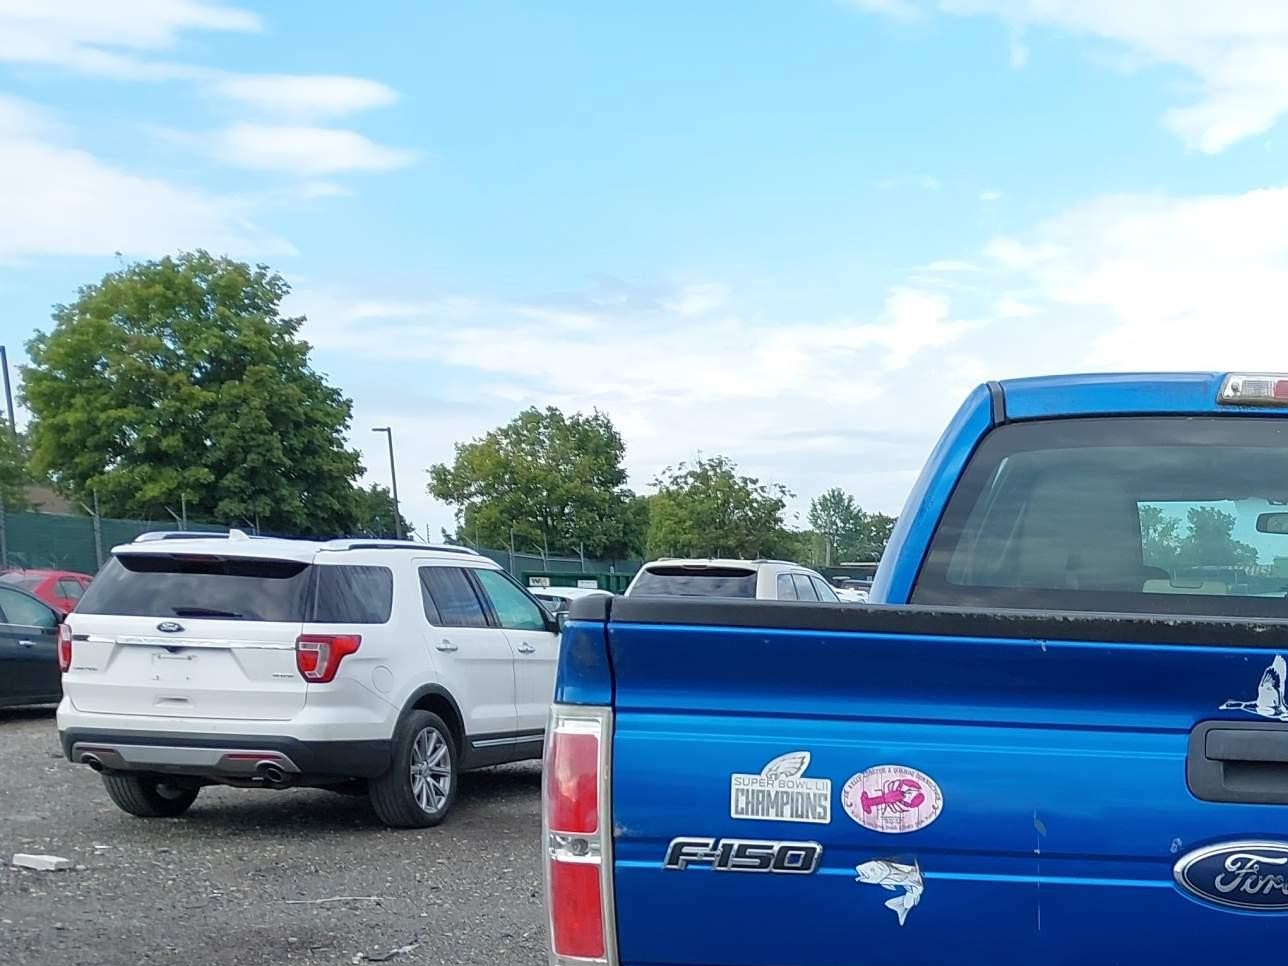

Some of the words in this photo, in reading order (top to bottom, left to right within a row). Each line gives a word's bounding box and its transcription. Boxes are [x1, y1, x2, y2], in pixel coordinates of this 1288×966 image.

[734, 777, 775, 788] SUPER
[778, 779, 812, 790] BOWL
[734, 788, 828, 820] CHAMPIONS
[663, 836, 823, 874] F-150
